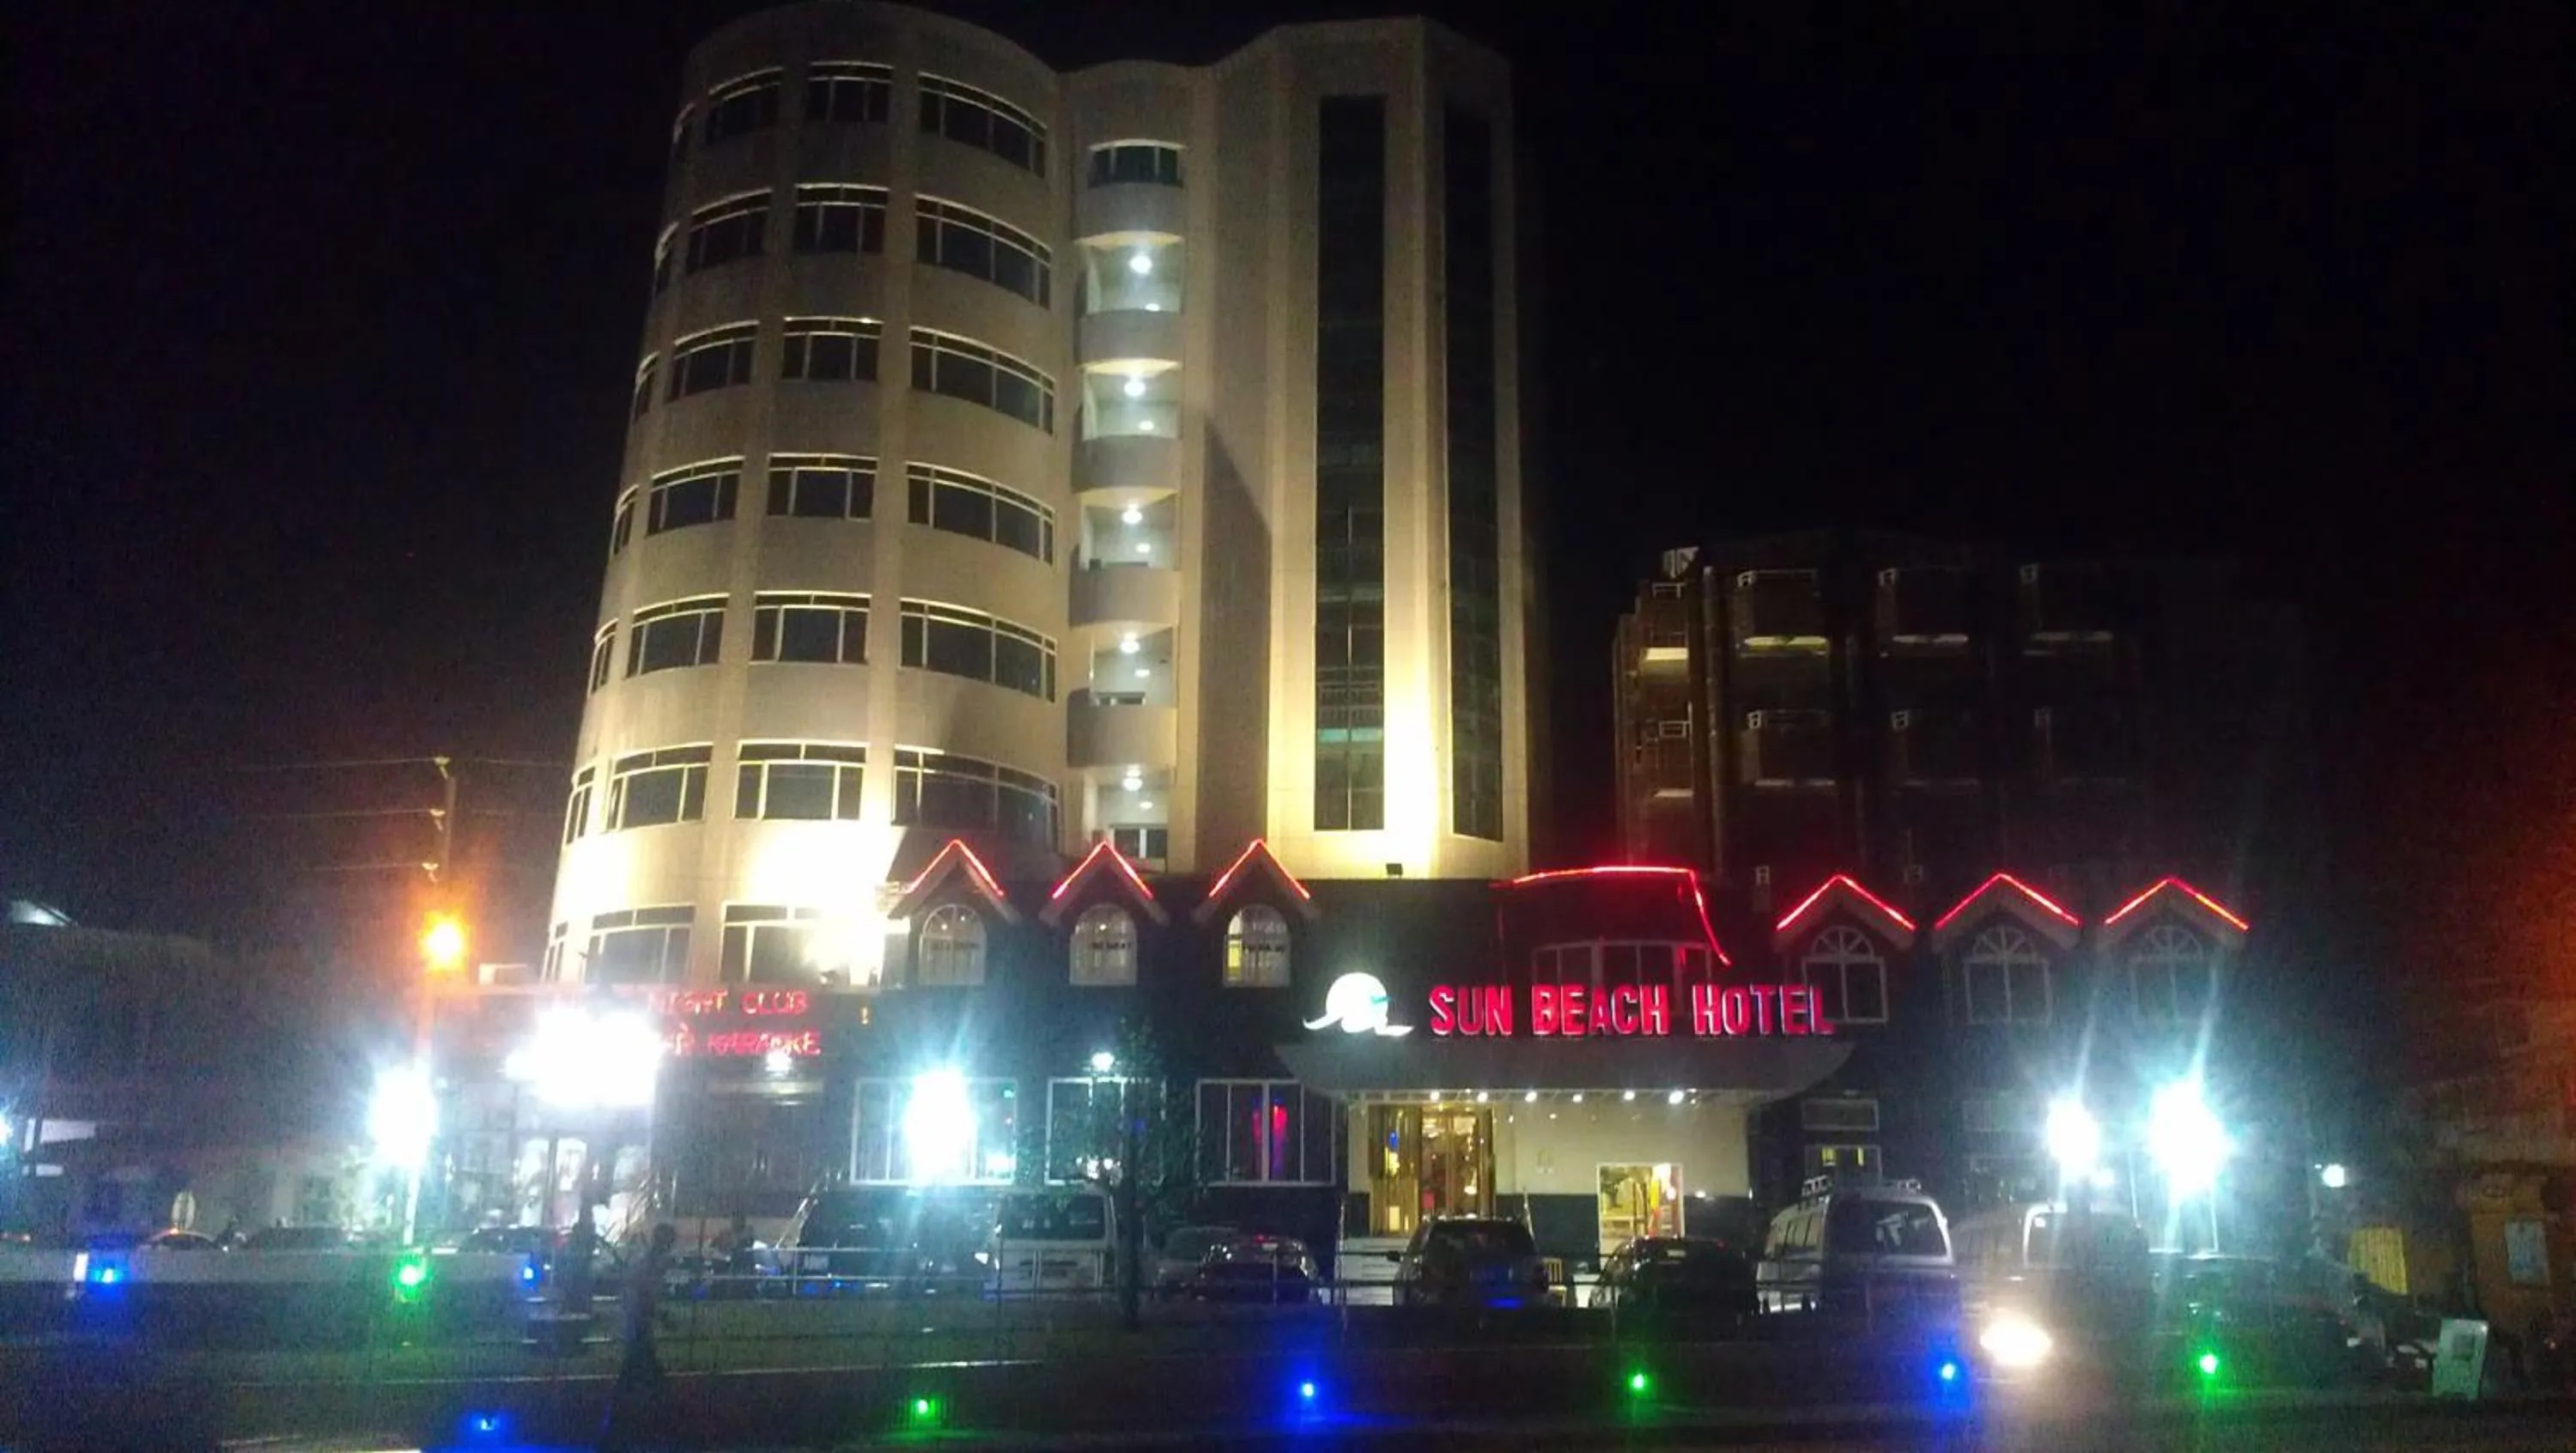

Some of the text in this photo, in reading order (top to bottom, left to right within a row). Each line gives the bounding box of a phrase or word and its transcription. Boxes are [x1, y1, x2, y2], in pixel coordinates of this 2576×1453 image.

[647, 988, 810, 1015] NIGHT CLUB
[1428, 983, 1836, 1037] SUN BEACH HOTEL
